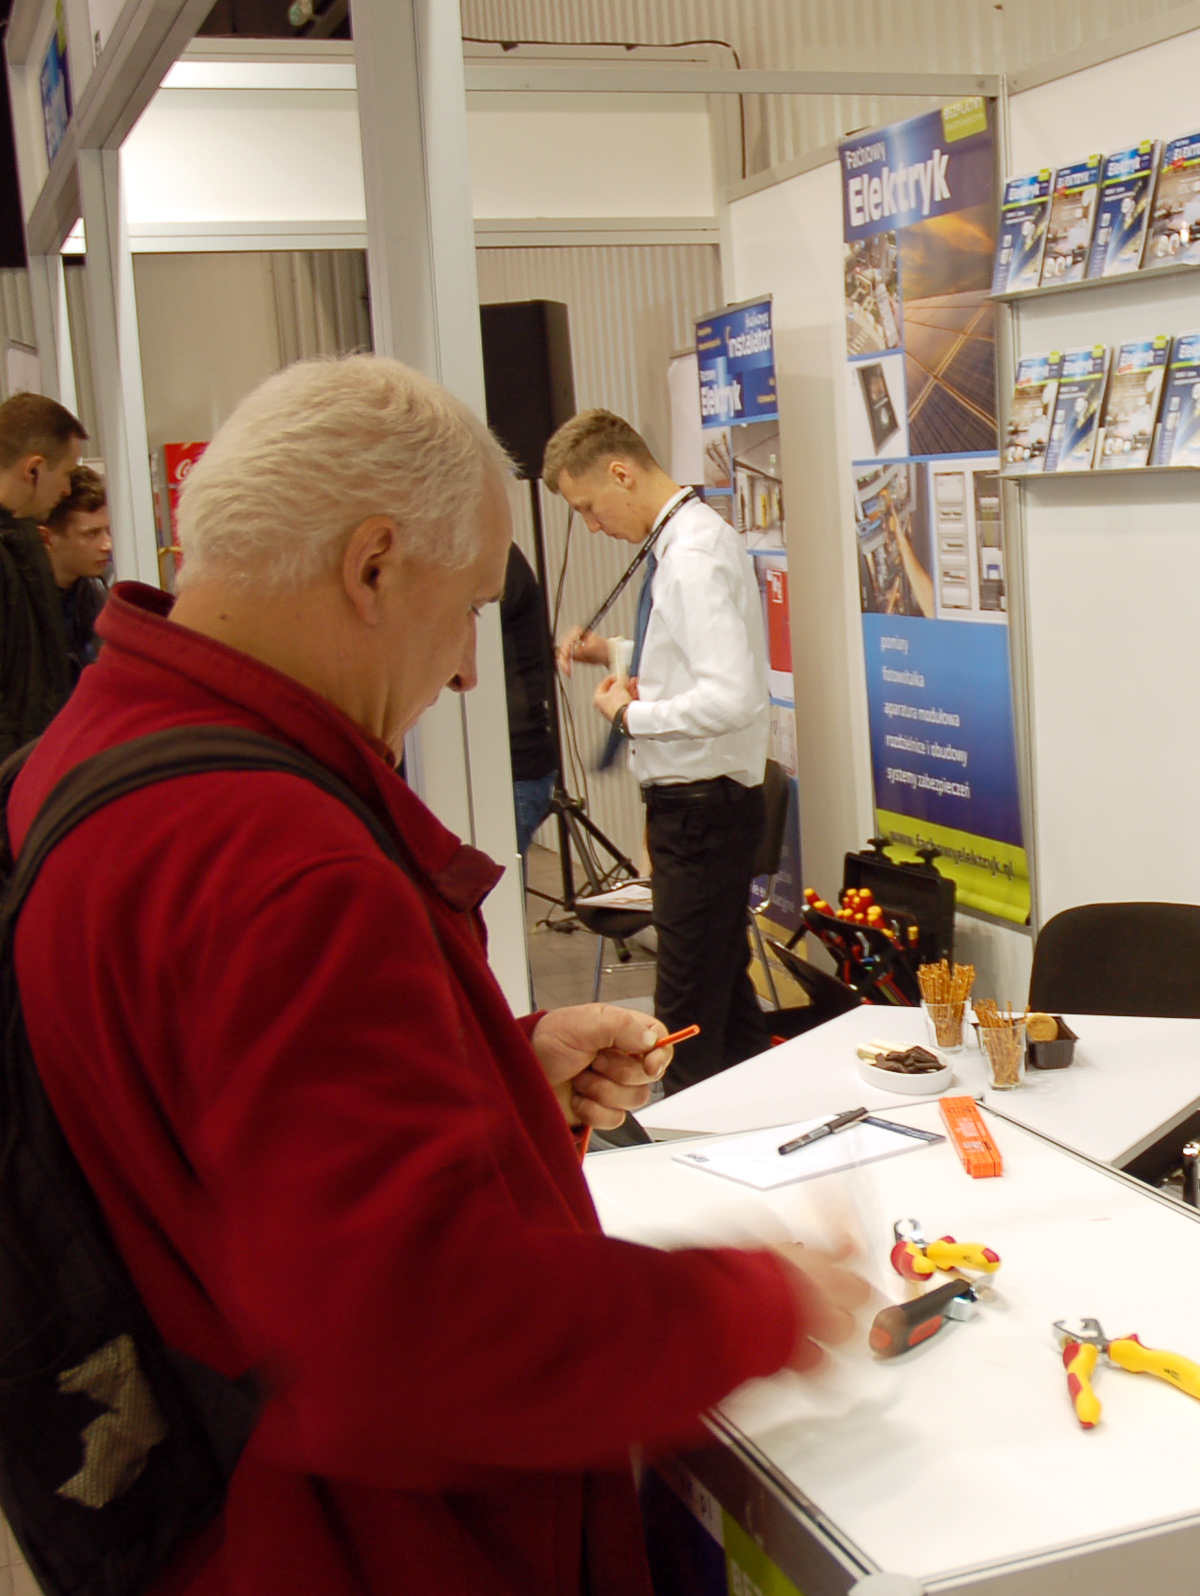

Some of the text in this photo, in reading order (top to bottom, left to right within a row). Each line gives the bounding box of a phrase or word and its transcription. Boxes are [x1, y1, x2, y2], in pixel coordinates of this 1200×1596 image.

[844, 141, 886, 170] Fachowy
[849, 149, 951, 227] Elektryk
[884, 702, 918, 719] aparatura
[886, 767, 971, 799] systemy zabezpieczeń
